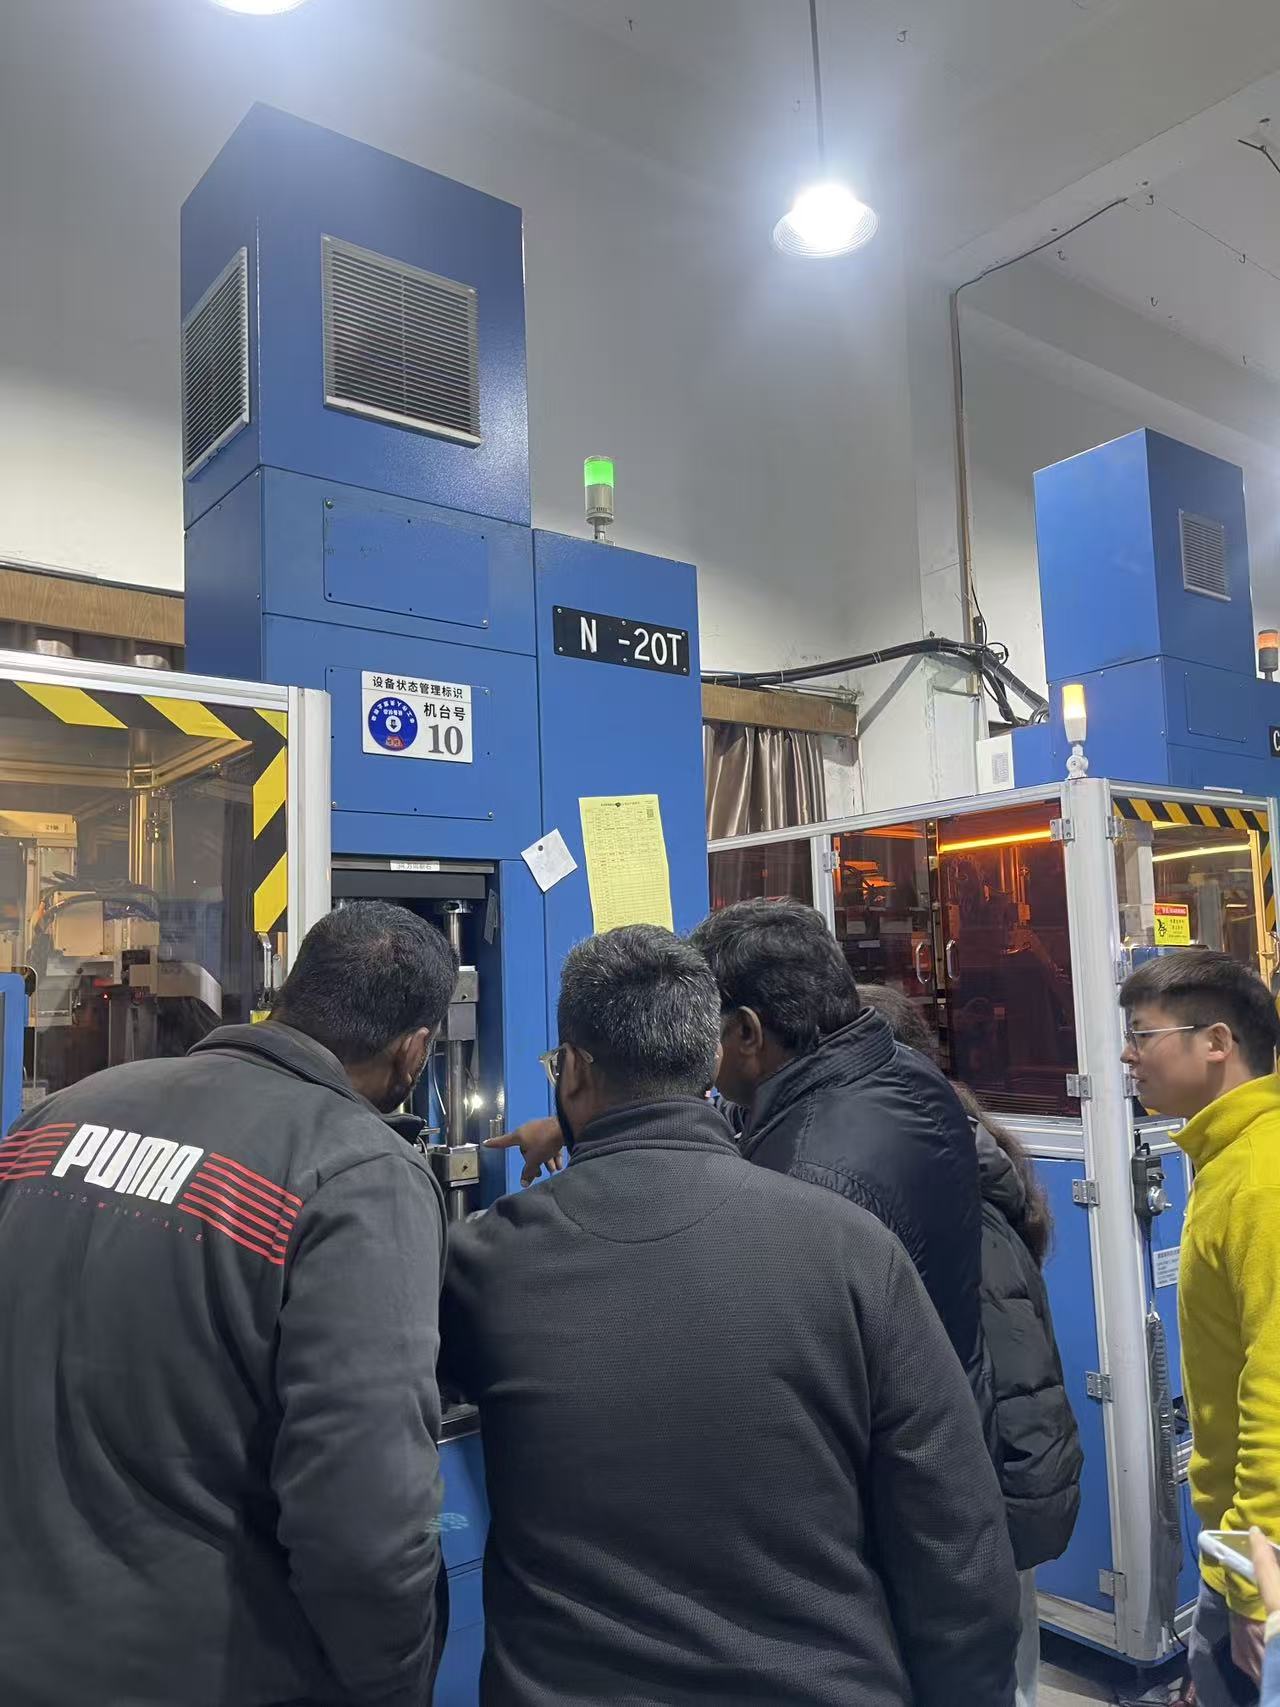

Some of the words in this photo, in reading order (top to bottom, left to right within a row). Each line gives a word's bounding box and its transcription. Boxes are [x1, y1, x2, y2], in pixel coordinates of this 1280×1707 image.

[580, 616, 598, 653] N
[618, 628, 682, 666] -20T
[372, 676, 464, 699] 设备状态管理标识
[423, 702, 466, 721] 机台号
[428, 724, 464, 756] 10
[52, 1123, 205, 1205] PUMA
